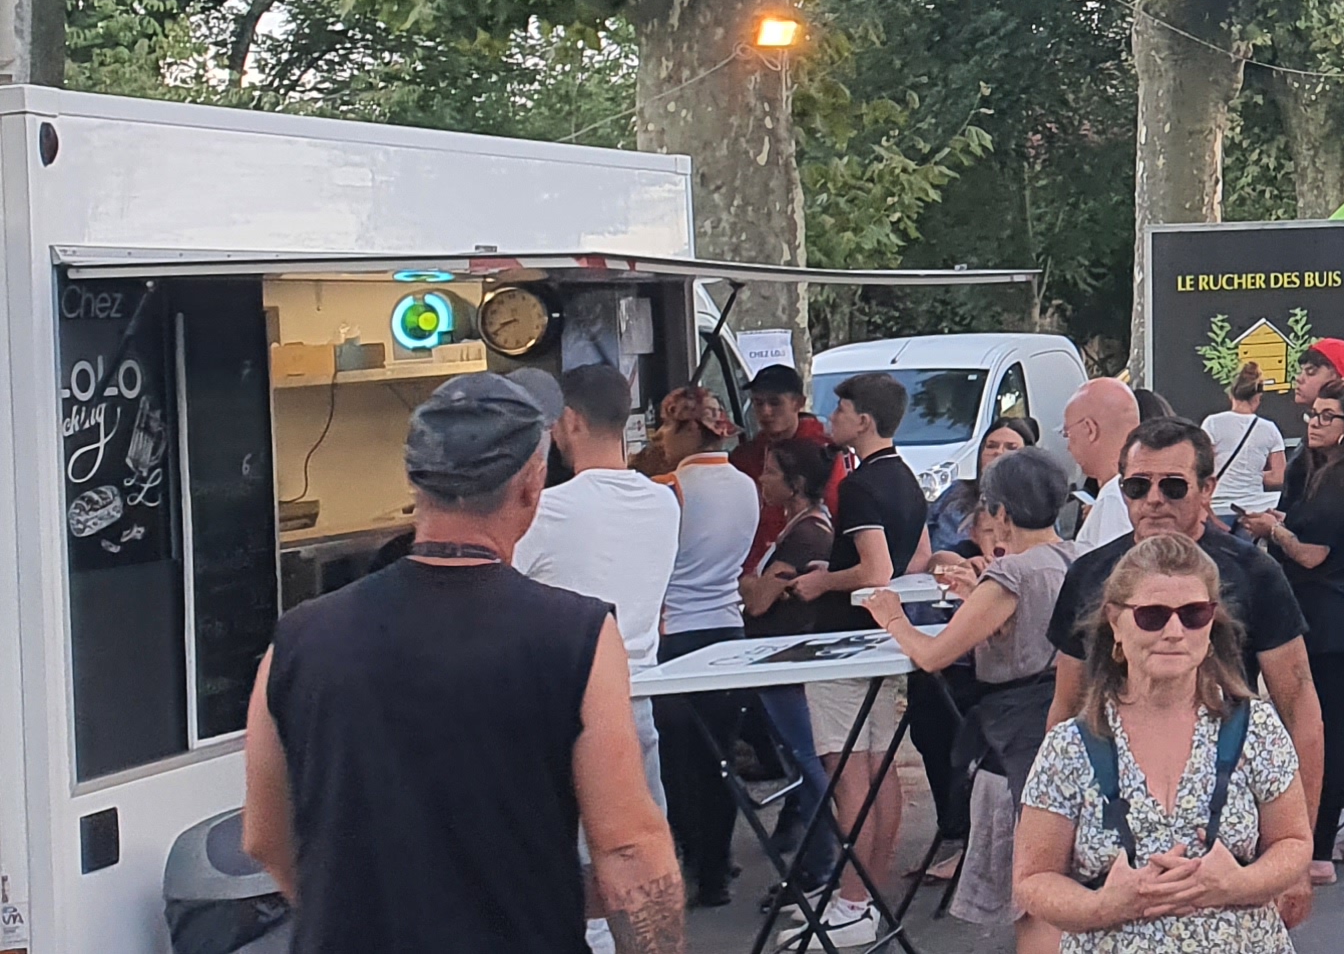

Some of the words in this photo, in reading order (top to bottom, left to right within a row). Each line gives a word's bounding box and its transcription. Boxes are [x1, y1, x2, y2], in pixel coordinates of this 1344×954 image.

[1177, 275, 1195, 292] LE
[1198, 273, 1266, 291] RUCHER
[1269, 272, 1300, 289] DES
[1304, 270, 1342, 288] BUIS
[61, 284, 123, 319] Chez
